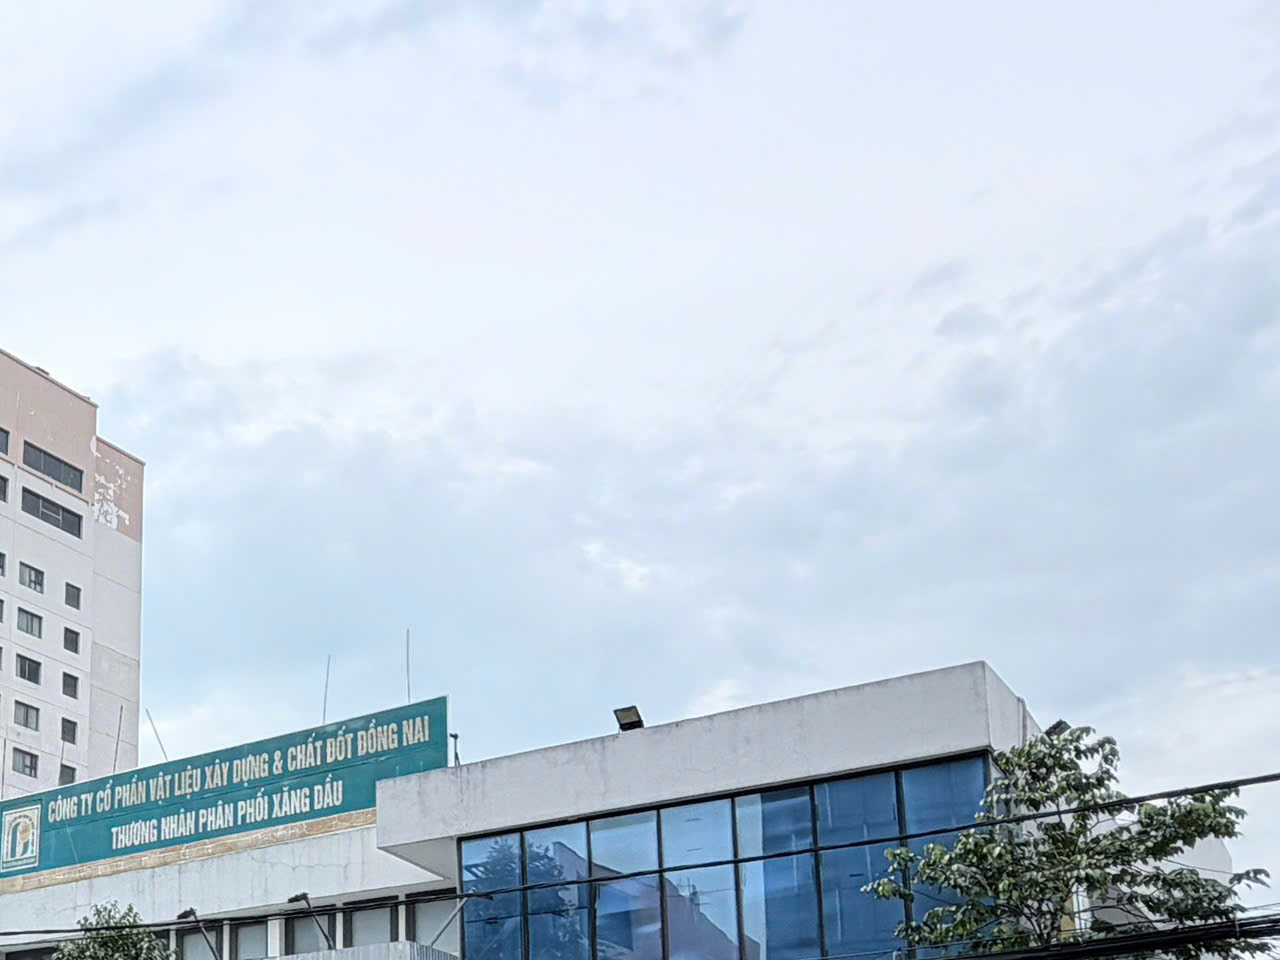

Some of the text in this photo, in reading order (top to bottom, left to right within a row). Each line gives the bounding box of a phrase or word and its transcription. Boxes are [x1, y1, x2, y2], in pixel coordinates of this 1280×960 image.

[48, 715, 430, 823] CÔNG TY CỔ PHẦN VẬT LIỆU XÂY DỰNG & CHẤT ĐỐT ĐỒNG NAI
[111, 773, 344, 850] THƯƠNG NHÂN PHÂN PHỐI XĂNG DẦU
